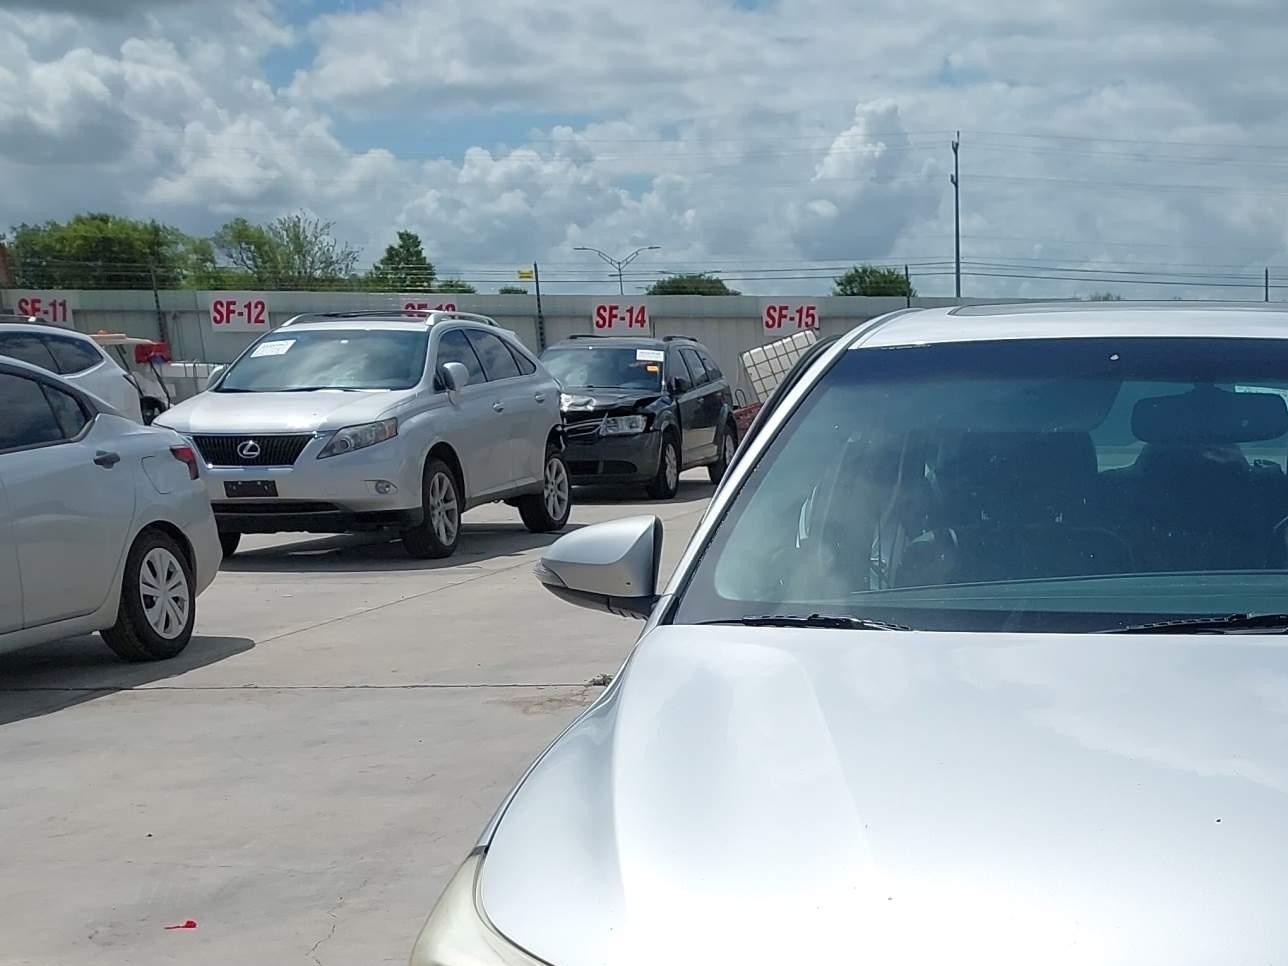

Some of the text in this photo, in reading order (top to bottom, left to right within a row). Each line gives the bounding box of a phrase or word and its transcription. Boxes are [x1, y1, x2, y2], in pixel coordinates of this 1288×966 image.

[17, 298, 67, 322] SF-11
[212, 300, 266, 325] SF-12
[595, 304, 646, 329] SF-14
[764, 305, 816, 329] SF-15
